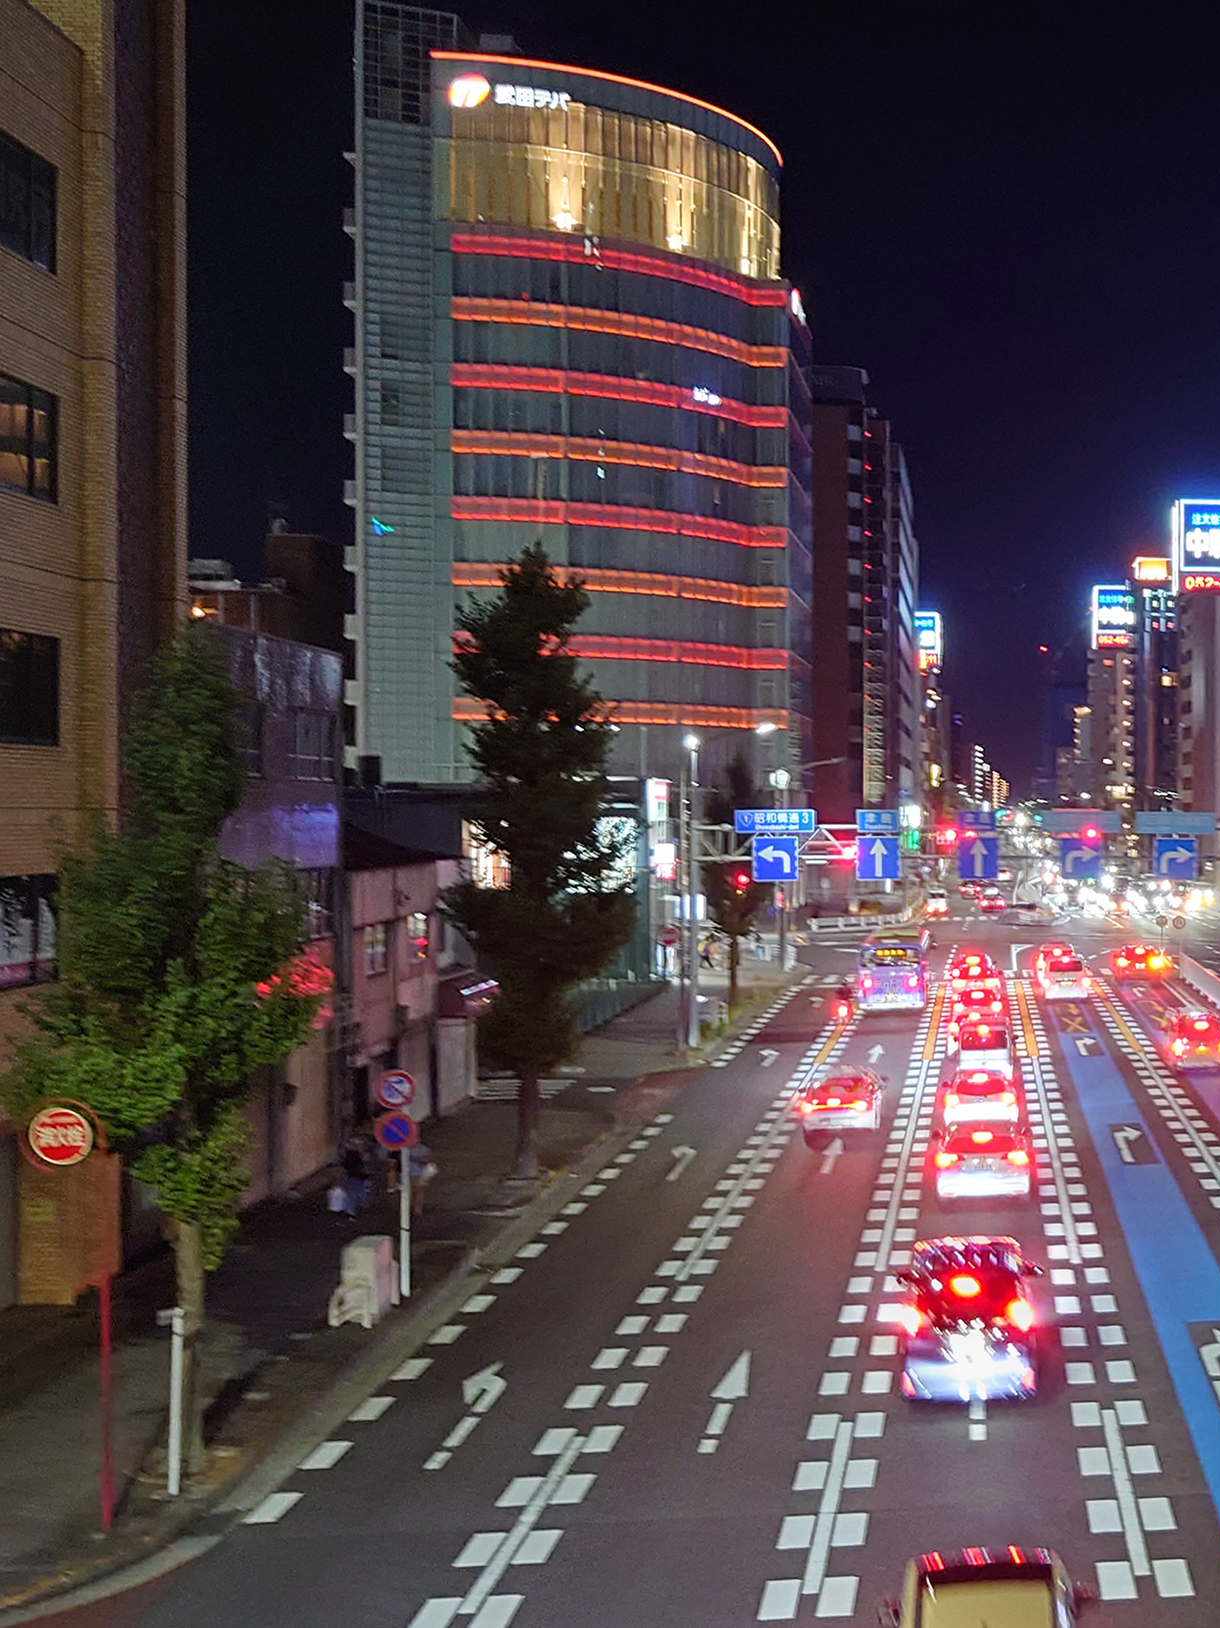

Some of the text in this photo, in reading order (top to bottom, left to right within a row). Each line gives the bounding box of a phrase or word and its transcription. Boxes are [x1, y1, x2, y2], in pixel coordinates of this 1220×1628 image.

[494, 83, 572, 111] 武田テバ
[754, 812, 799, 824] 昭和橋通
[801, 812, 809, 824] 3
